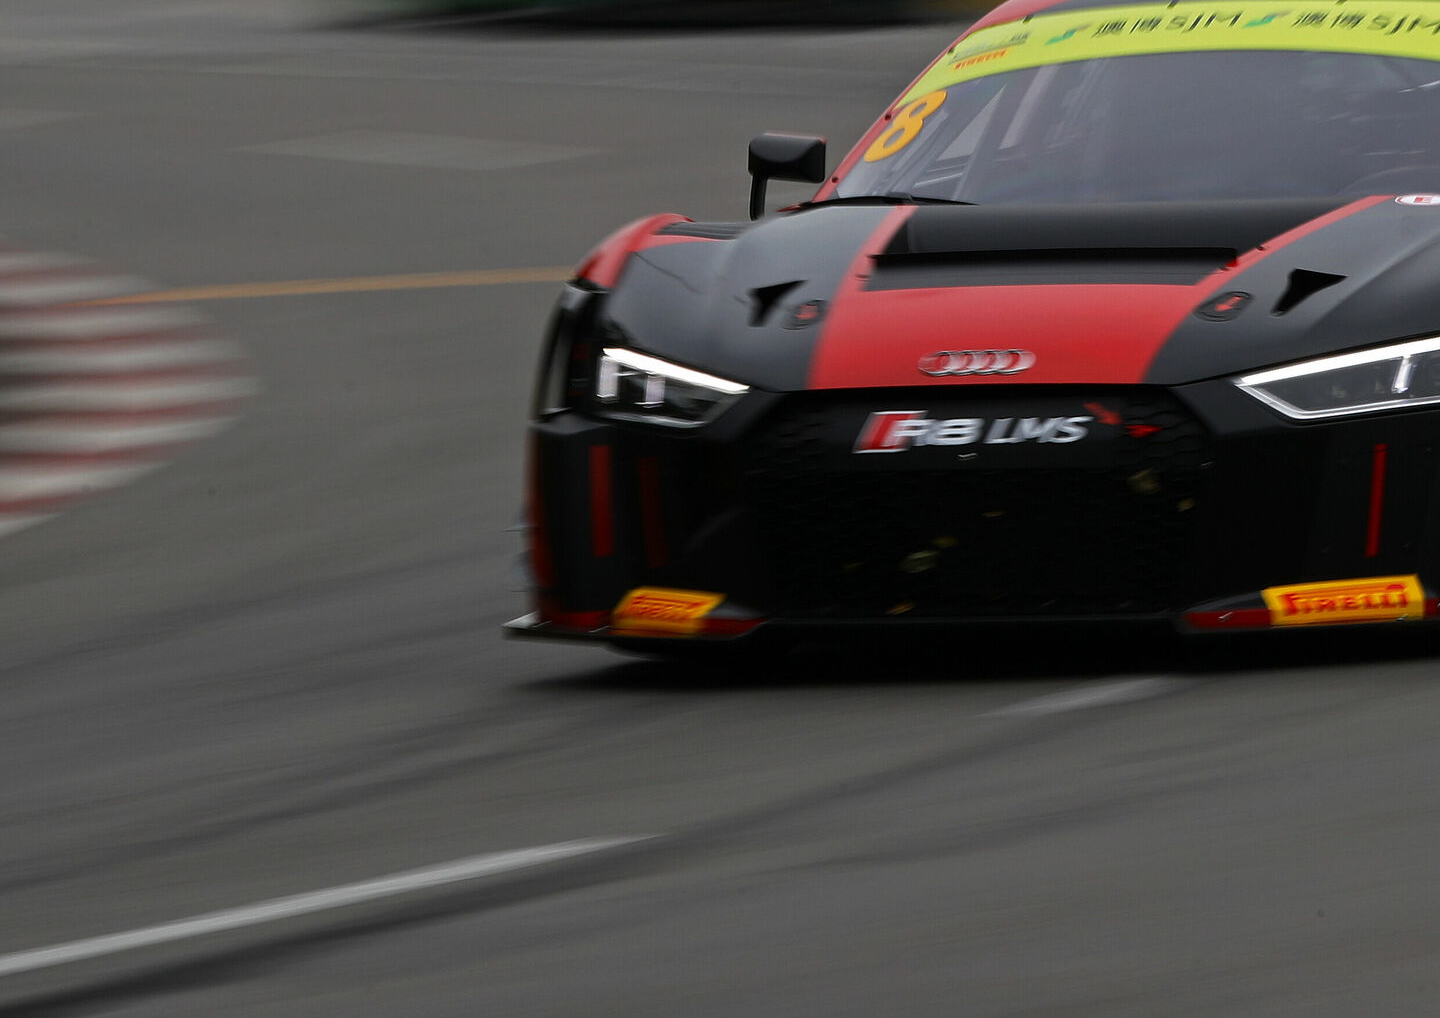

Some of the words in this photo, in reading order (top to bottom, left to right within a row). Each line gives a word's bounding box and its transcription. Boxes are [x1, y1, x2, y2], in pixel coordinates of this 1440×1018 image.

[1165, 10, 1245, 34] SJM
[863, 88, 948, 163] 8
[876, 416, 986, 447] R8
[983, 415, 1096, 445] LMS
[1278, 582, 1409, 617] PIRELLI
